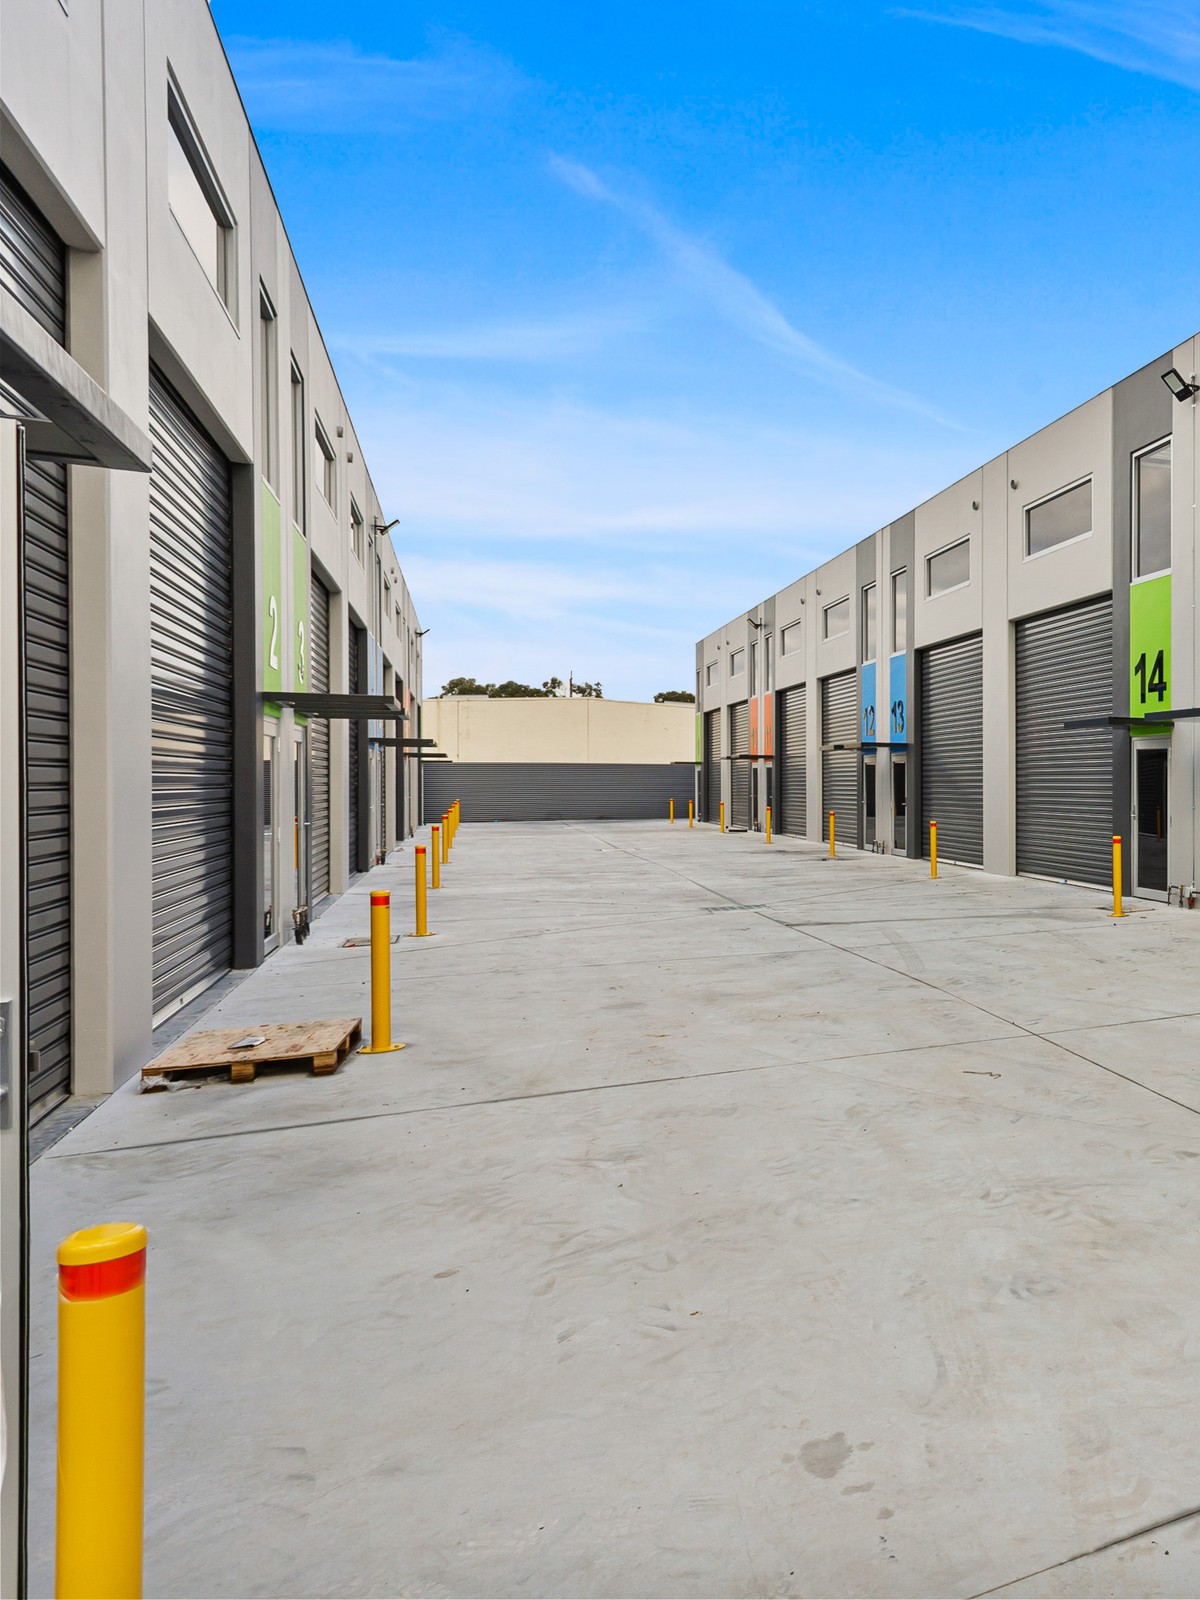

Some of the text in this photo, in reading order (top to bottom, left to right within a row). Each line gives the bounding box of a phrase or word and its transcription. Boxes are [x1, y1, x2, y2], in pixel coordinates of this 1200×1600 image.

[269, 595, 278, 671] 2
[298, 620, 305, 684] 3
[1135, 650, 1167, 704] 14
[863, 705, 875, 736] 12
[892, 700, 905, 733] 13
